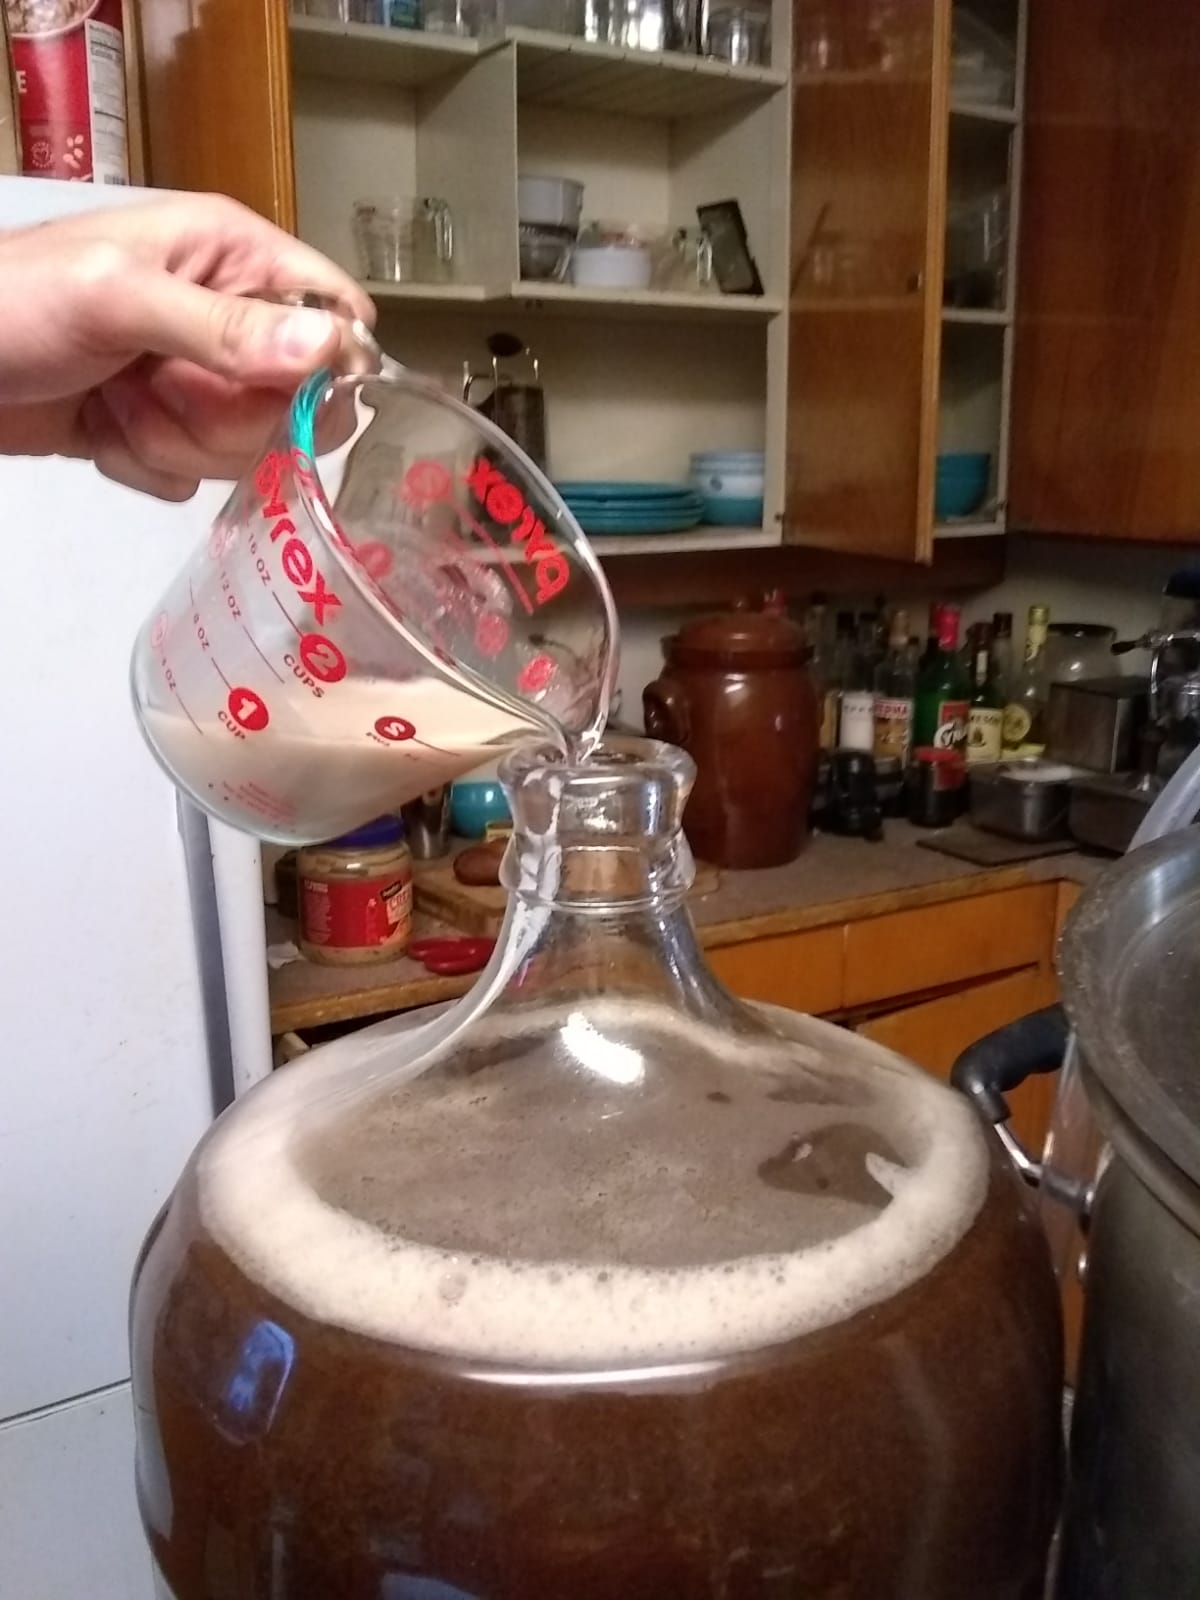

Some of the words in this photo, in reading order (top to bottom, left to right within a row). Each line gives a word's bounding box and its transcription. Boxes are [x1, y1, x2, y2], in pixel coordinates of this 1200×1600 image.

[256, 558, 271, 587] OZ
[228, 595, 242, 622] OZ
[197, 627, 210, 652] OZ
[165, 668, 177, 692] OZ
[283, 653, 325, 699] CUPS
[217, 709, 246, 740] CUP
